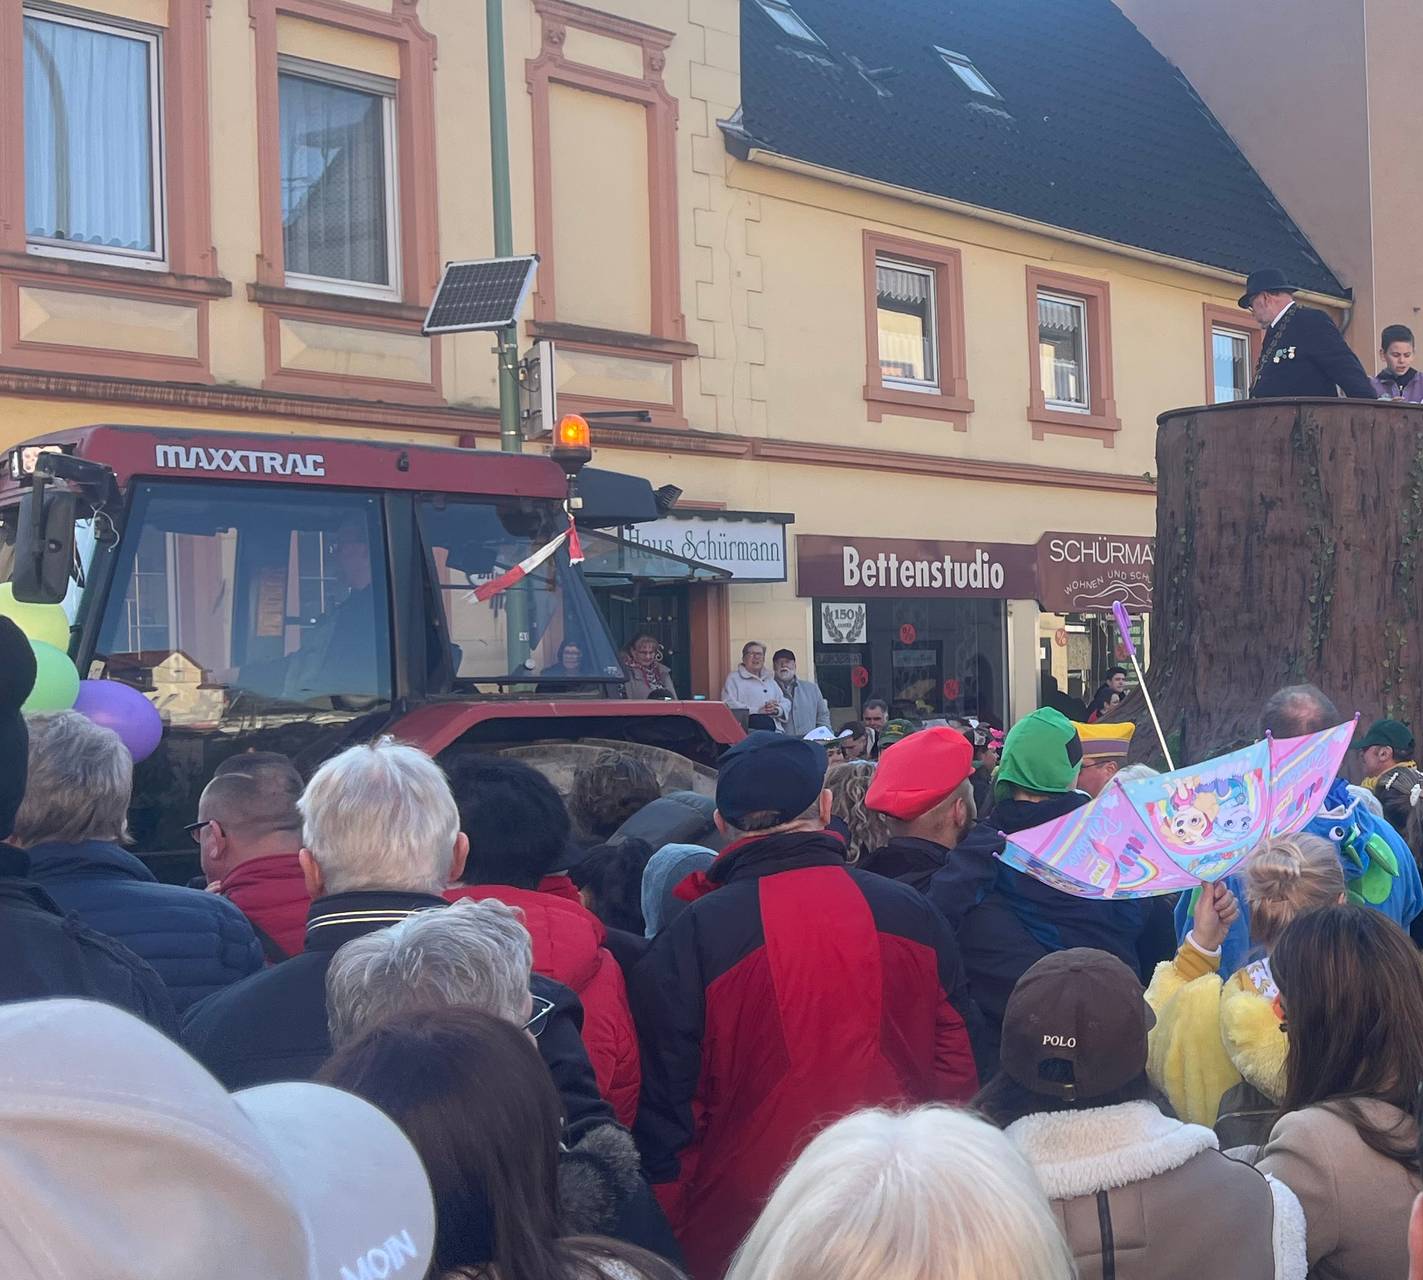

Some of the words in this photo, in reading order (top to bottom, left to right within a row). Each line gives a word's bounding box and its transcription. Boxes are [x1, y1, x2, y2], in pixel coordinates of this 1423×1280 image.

[155, 444, 325, 476] MAXXTRAC
[681, 530, 781, 561] Schürmann
[1049, 536, 1155, 565] SCHÜRMA
[842, 546, 1004, 590] Bettenstudio
[1064, 576, 1104, 595] WOHNEN
[1107, 570, 1127, 581] UND
[1129, 571, 1152, 583] SCHL
[834, 608, 855, 620] 150
[1042, 1035, 1077, 1048] POLO
